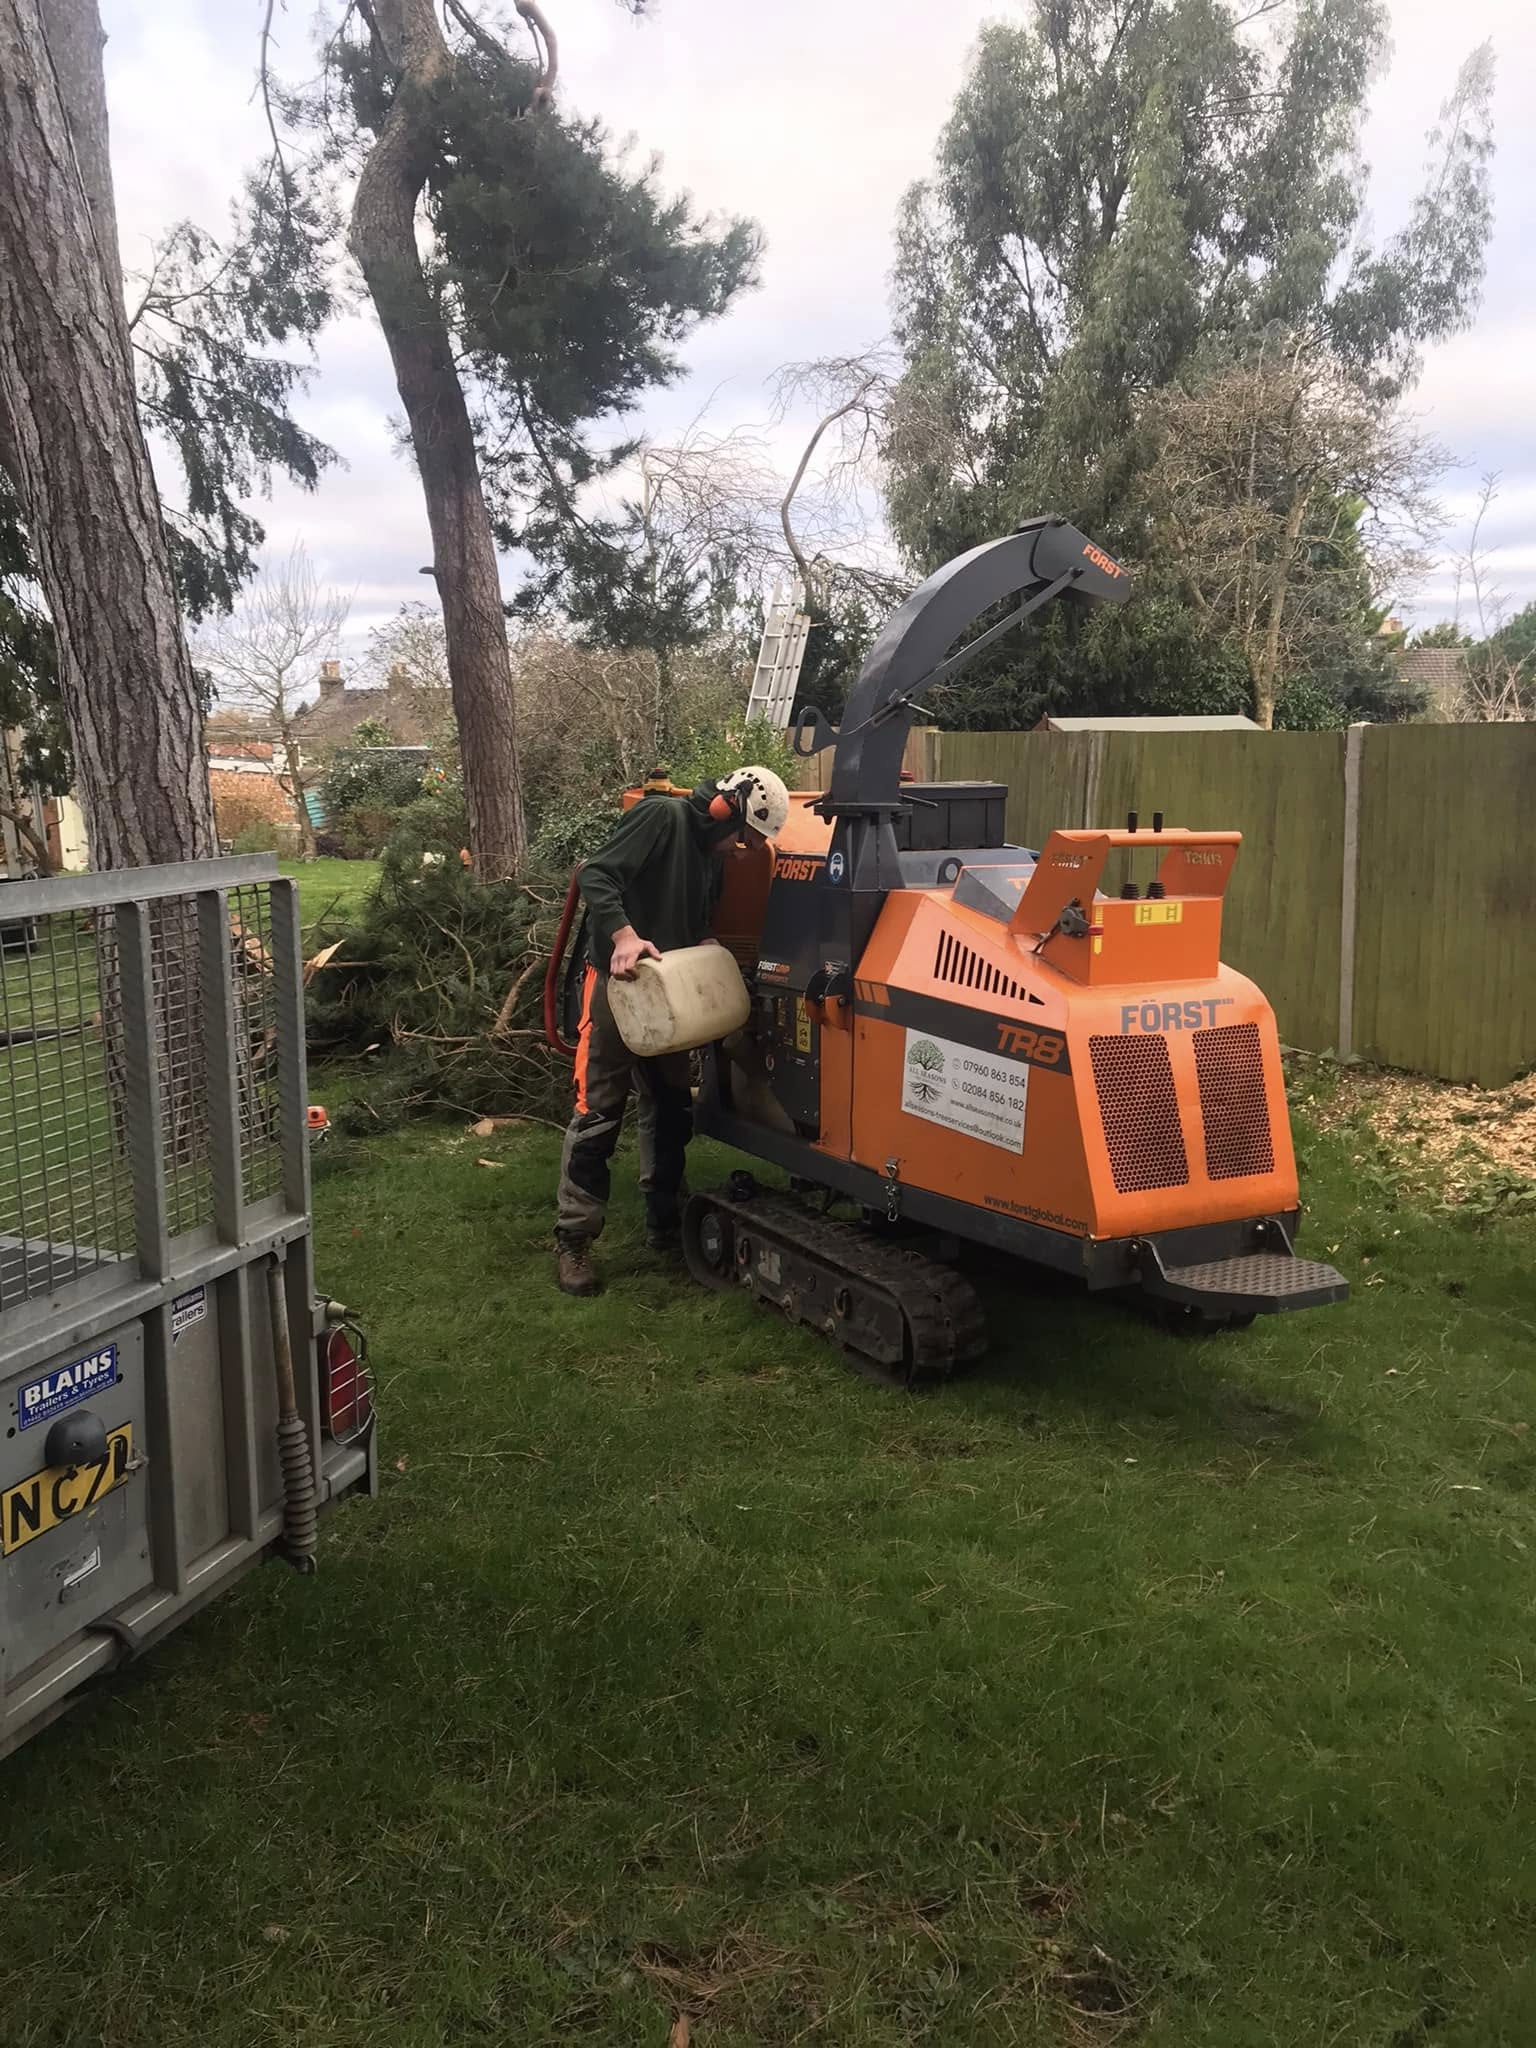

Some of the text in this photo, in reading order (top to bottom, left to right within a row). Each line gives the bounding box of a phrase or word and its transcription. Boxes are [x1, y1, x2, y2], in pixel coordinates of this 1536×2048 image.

[997, 1022, 1064, 1065] TR8
[963, 1060, 1025, 1089] 07960 863 854
[961, 1081, 987, 1099] 02084
[989, 1091, 1006, 1105] 856
[1008, 1097, 1025, 1112] 182
[25, 1351, 112, 1408] BLAINS
[28, 1372, 109, 1416] Trailers & Tyres
